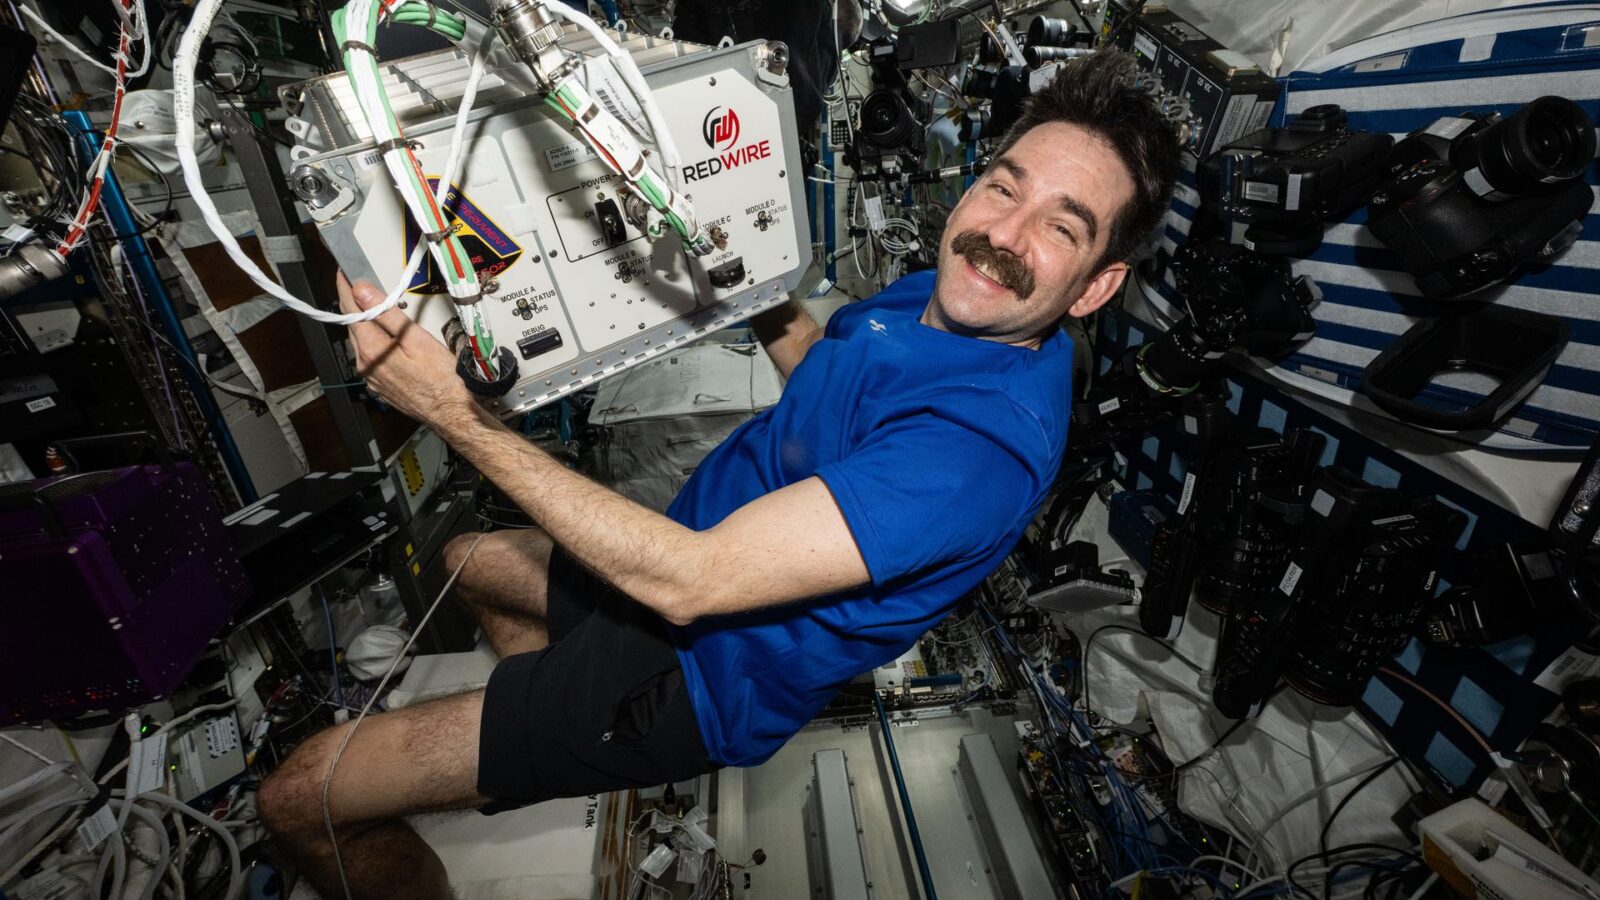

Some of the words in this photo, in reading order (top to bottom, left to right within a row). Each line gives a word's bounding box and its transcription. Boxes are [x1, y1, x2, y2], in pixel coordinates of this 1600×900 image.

[682, 140, 771, 184] REDWIRE
[581, 173, 612, 189] POWER
[584, 209, 595, 218] ON
[745, 201, 770, 215] MODULE
[767, 205, 788, 215] STATUS
[702, 217, 726, 231] ODULE
[726, 215, 732, 223] C
[604, 252, 630, 265] MODULE
[630, 254, 654, 266] STATUS
[711, 251, 734, 264] LAUNCH
[634, 268, 646, 277] OPS
[500, 288, 530, 303] MODULE
[529, 290, 556, 303] STATUS
[534, 304, 549, 314] OPS
[521, 324, 546, 337] DEBUG
[584, 801, 598, 829] Tank
